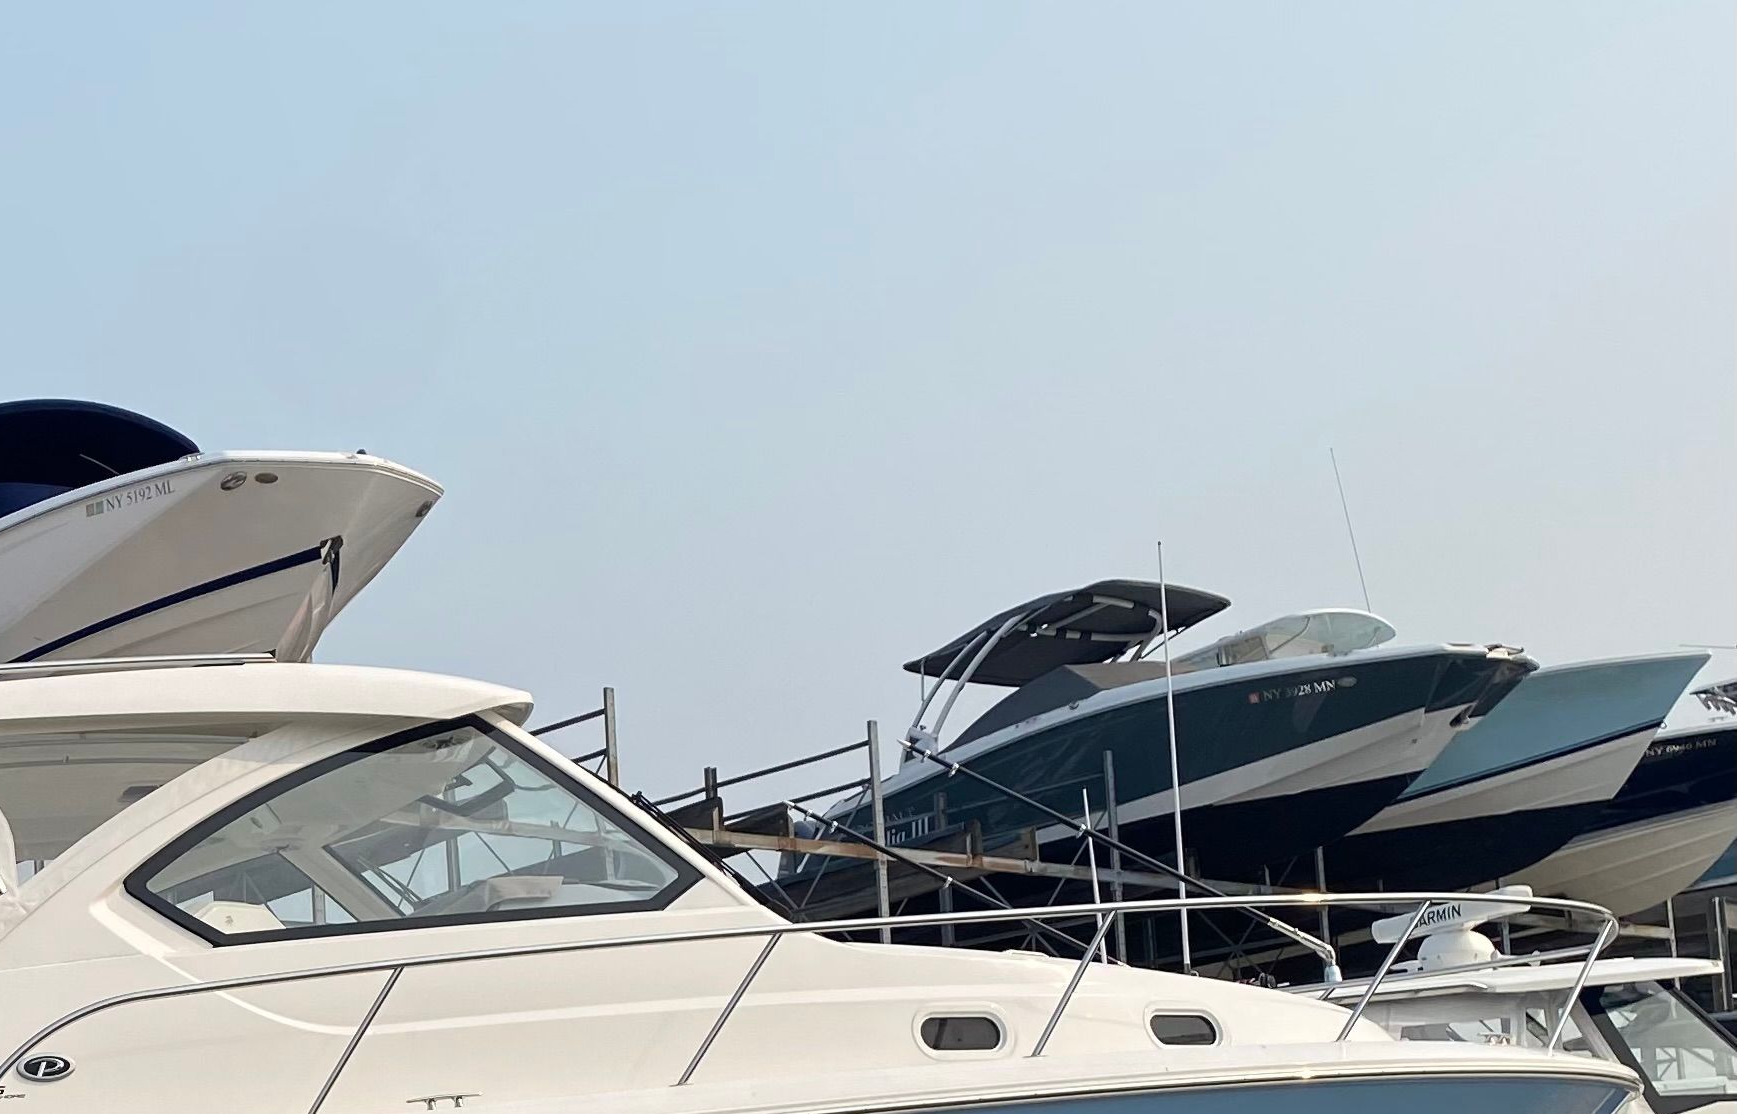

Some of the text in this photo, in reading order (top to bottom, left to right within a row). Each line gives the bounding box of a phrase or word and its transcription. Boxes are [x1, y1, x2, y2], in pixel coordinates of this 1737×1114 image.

[106, 480, 176, 512] NY 5192 ML
[1263, 687, 1282, 702] NY
[1313, 679, 1336, 694] MN
[1645, 746, 1664, 758] NY
[1414, 903, 1463, 929] ARMIN
